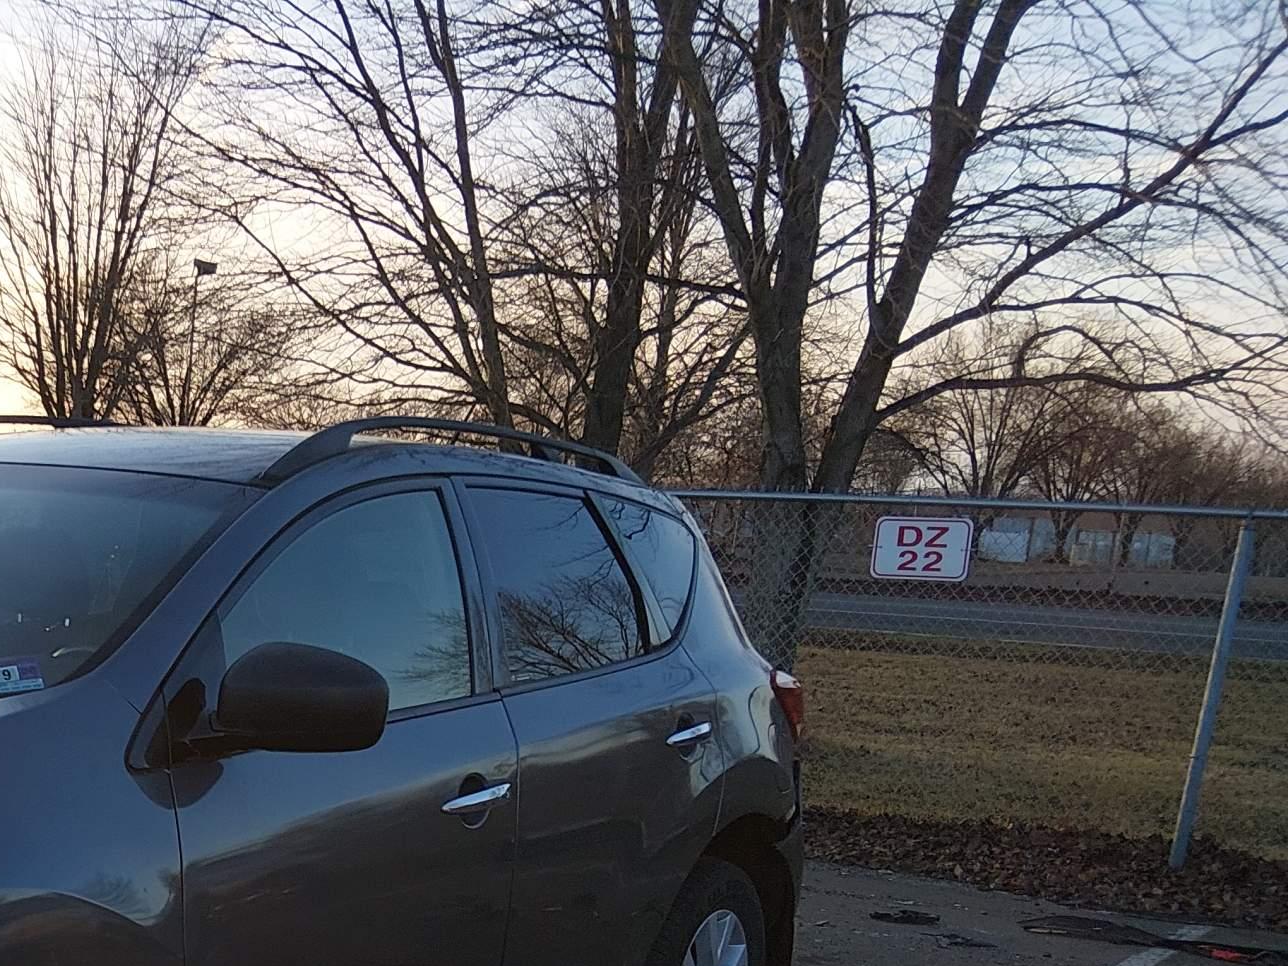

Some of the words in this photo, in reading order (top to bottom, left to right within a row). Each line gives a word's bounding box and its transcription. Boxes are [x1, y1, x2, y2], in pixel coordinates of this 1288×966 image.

[896, 525, 950, 548] DZ
[896, 550, 943, 572] 22
[1, 668, 12, 681] 9
